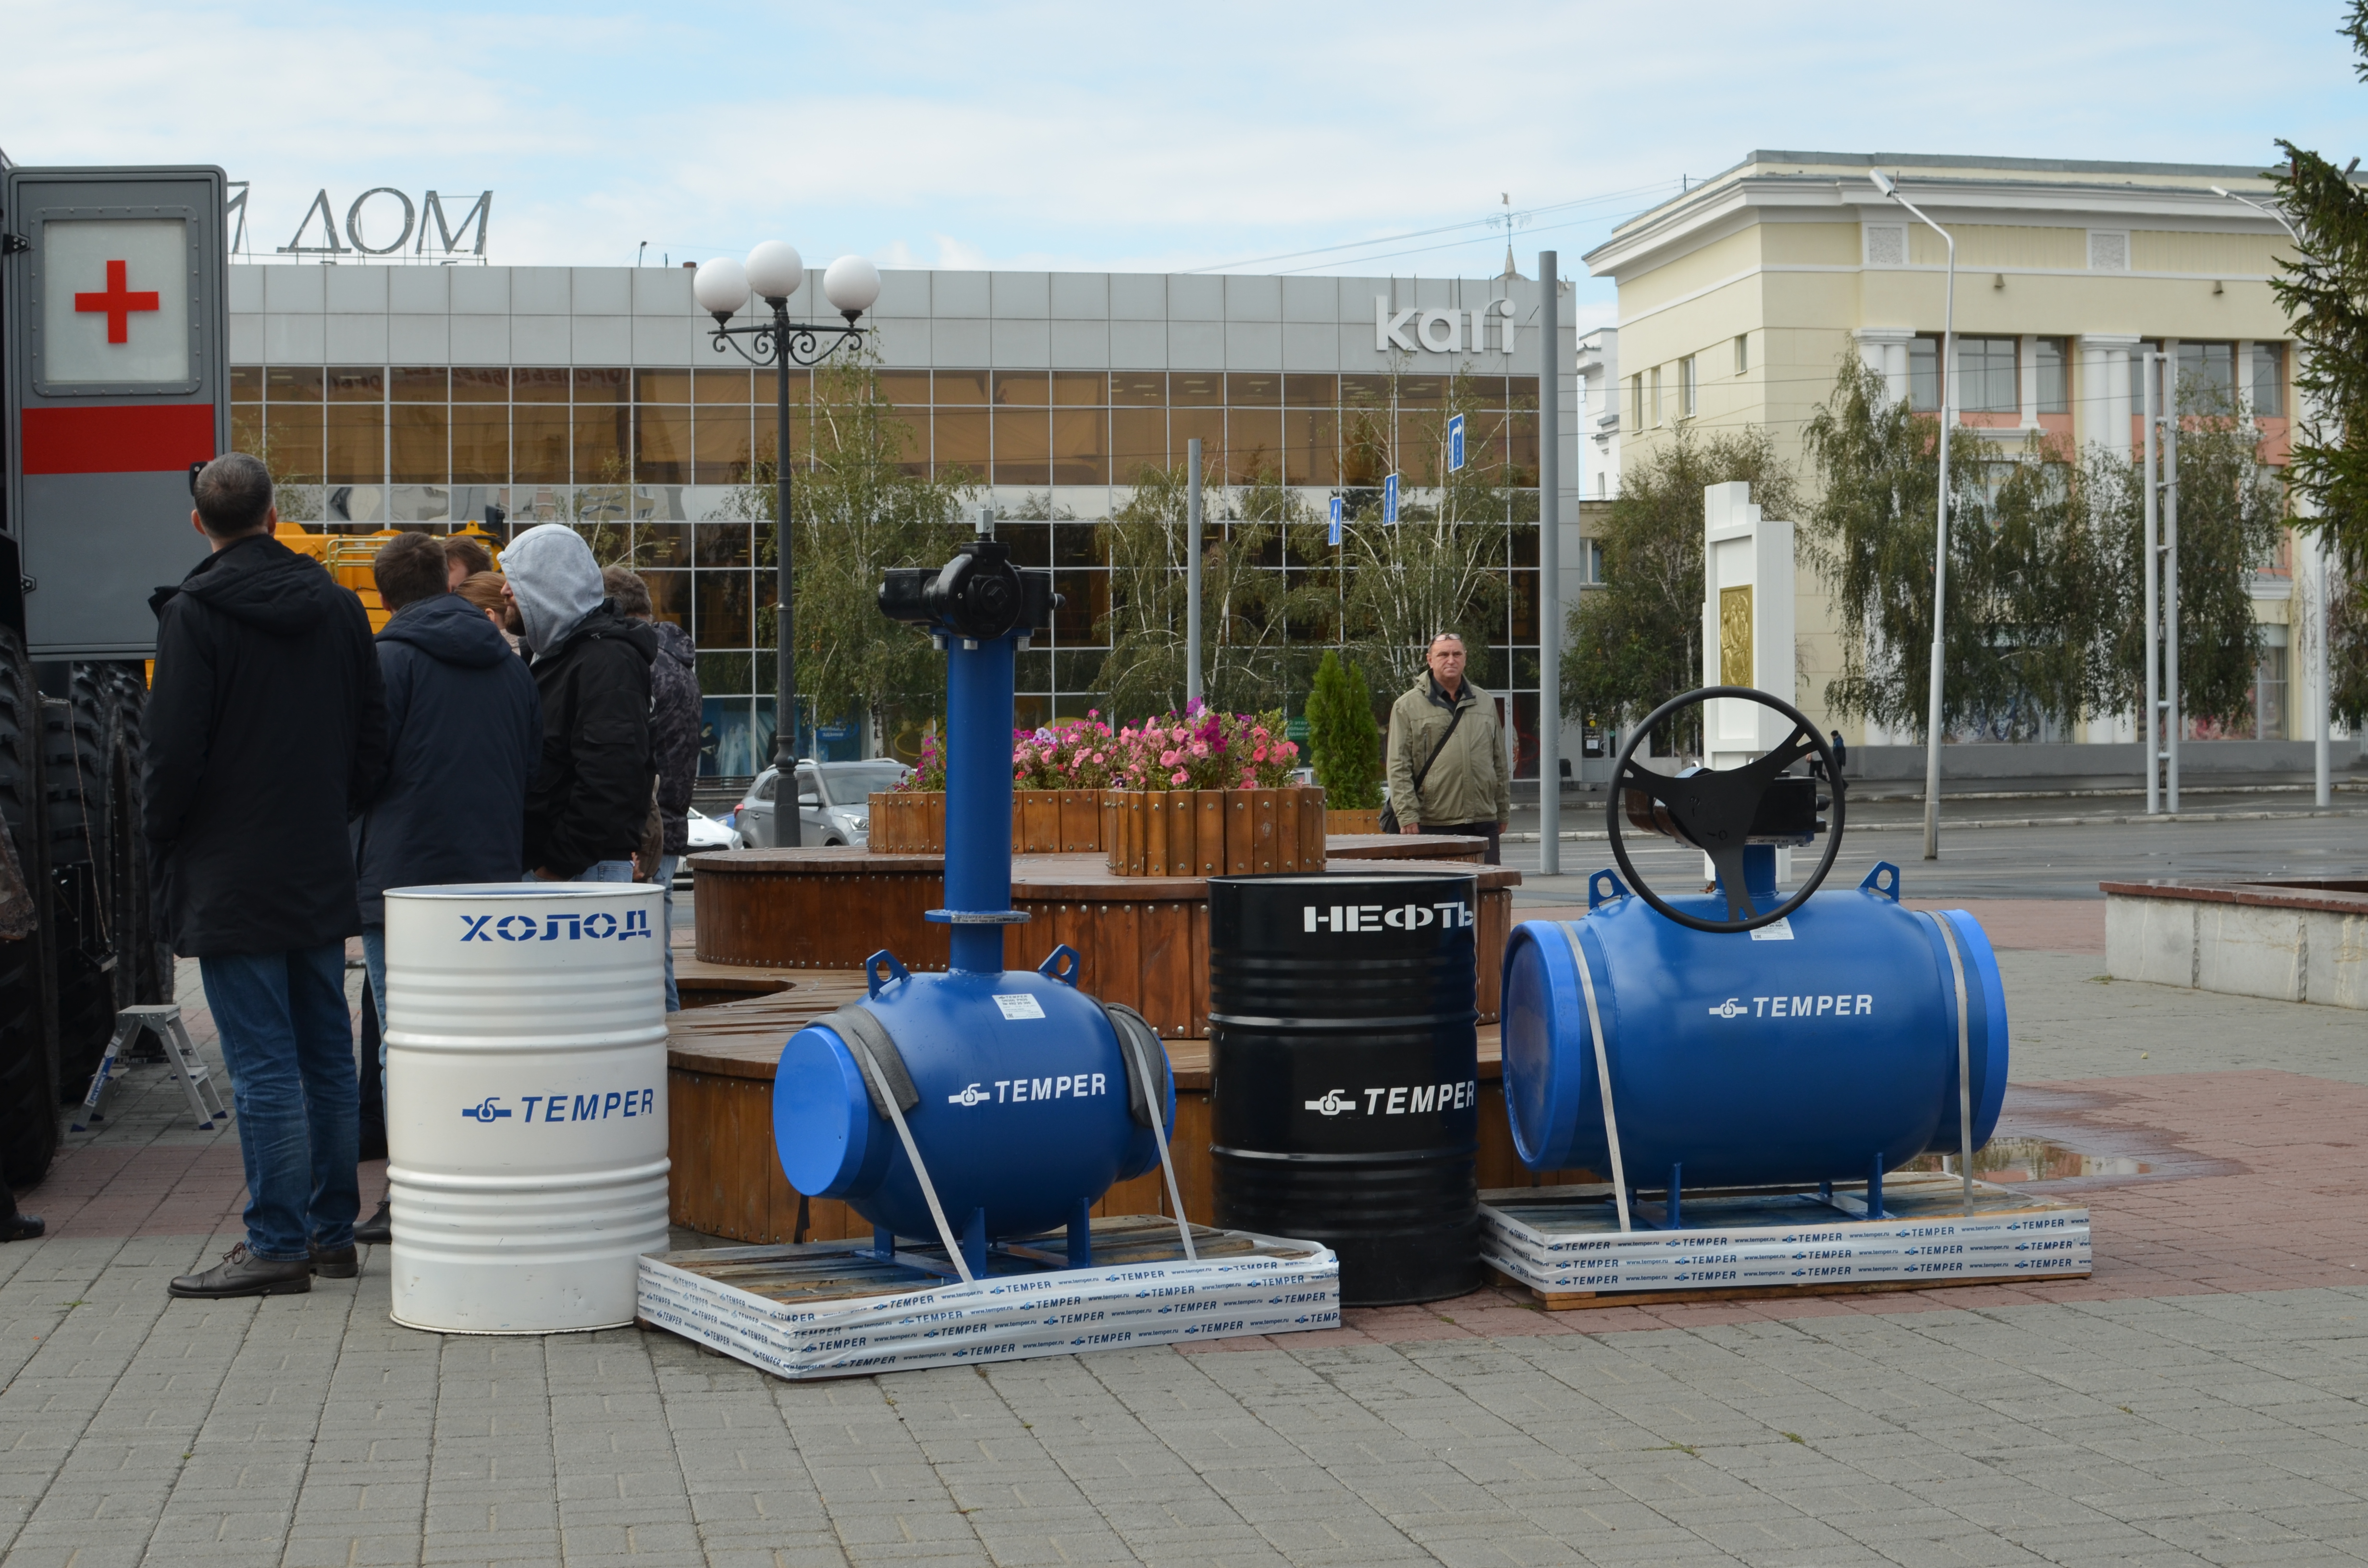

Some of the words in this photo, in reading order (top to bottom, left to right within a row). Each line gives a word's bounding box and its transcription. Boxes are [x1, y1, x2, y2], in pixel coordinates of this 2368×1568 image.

[277, 187, 493, 255] ДОМ
[1375, 295, 1516, 353] kari
[460, 910, 651, 942] ХОЛОД
[1304, 901, 1473, 932] НЕФТЬ
[1753, 994, 1873, 1017] TEMPER
[995, 1073, 1106, 1103] TEMPER
[1364, 1080, 1474, 1115] TEMPER
[521, 1089, 654, 1123] TEMPER
[1566, 1242, 1610, 1250] TEMPER
[1683, 1237, 1727, 1246] TEMPER
[1799, 1233, 1842, 1242] TEMPER
[1912, 1227, 1954, 1237] TEMPER
[2023, 1219, 2064, 1229] TEMPER
[1573, 1260, 1619, 1268] TEMPER
[1692, 1255, 1736, 1264] TEMPER
[1809, 1250, 1851, 1259] TEMPER
[1921, 1245, 1962, 1255] TEMPER
[2031, 1240, 2072, 1250] TEMPER
[1516, 1265, 1529, 1278] TEMPER
[1573, 1275, 1618, 1285] TEMPER
[1691, 1271, 1736, 1280] TEMPER
[1808, 1267, 1851, 1276] TEMPER
[1920, 1262, 1962, 1272] TEMPER
[2031, 1259, 2072, 1268] TEMPER
[678, 1278, 697, 1292] TEMPER
[778, 1312, 815, 1322] TEMPER
[690, 1294, 708, 1308] TEMPER
[890, 1295, 934, 1308] TEMPER
[941, 1290, 983, 1299] www.temper.ru
[1006, 1281, 1051, 1293] TEMPER
[1121, 1271, 1165, 1281] TEMPER
[653, 1294, 670, 1306] TEMPER
[699, 1311, 717, 1324] TEMPER
[748, 1329, 767, 1345] TEMPER
[794, 1327, 841, 1339] TEMPER
[849, 1321, 892, 1330] www.temper.ru
[916, 1311, 963, 1324] TEMPER
[970, 1305, 1013, 1315] www.temper.ru
[1036, 1297, 1081, 1309] TEMPER
[1151, 1286, 1194, 1298] TEMPER
[1201, 1282, 1241, 1291] www.temper.ru
[1262, 1275, 1305, 1287] TEMPER
[819, 1337, 866, 1351] TEMPER
[874, 1333, 917, 1342] www.temper.ru
[941, 1323, 987, 1336] TEMPER
[995, 1320, 1036, 1328] www.temper.ru
[1061, 1311, 1104, 1324] TEMPER
[1174, 1301, 1217, 1312] TEMPER
[1285, 1292, 1325, 1303] TEMPER
[663, 1311, 682, 1326] TEMPER
[711, 1331, 729, 1346] TEMPER
[759, 1352, 781, 1367] TEMPER
[783, 1362, 825, 1371] www.temper.ru
[849, 1356, 896, 1367] TEMPER
[970, 1343, 1015, 1356] TEMPER
[1088, 1332, 1131, 1344] TEMPER
[1138, 1329, 1178, 1337] www.temper.ru
[1201, 1321, 1243, 1333] TEMPER
